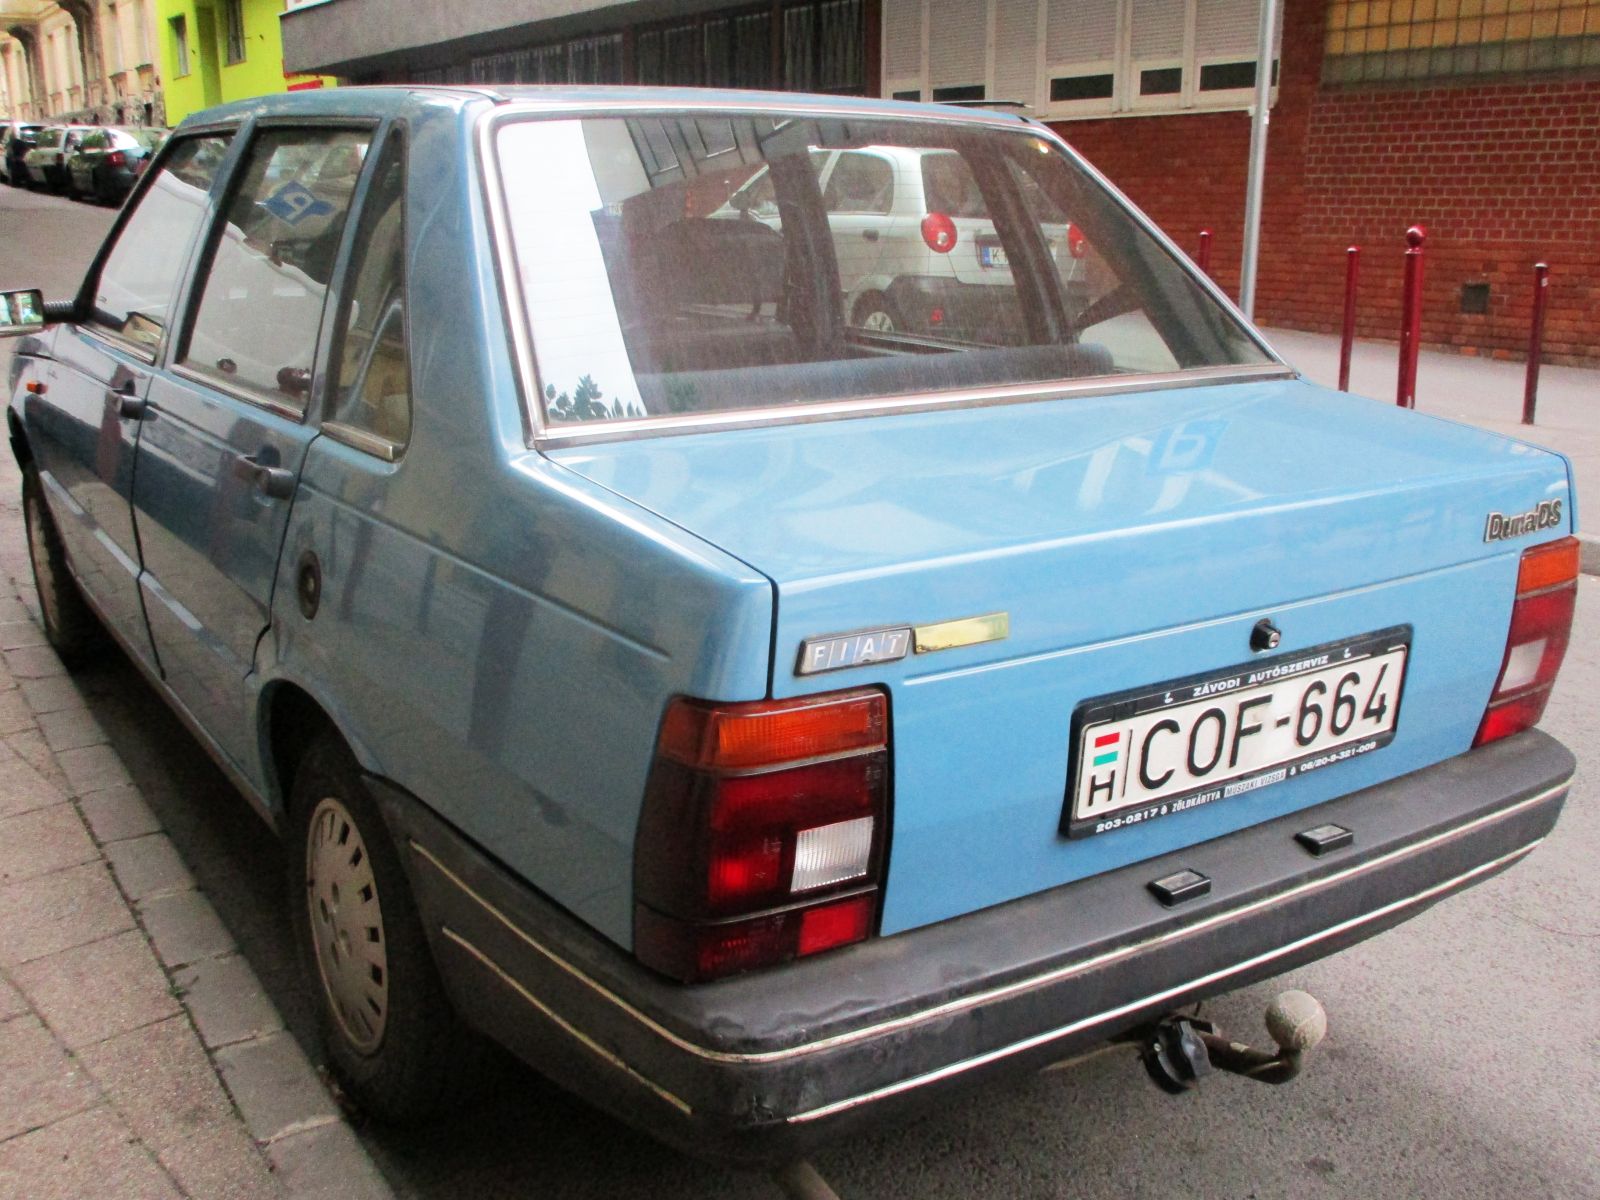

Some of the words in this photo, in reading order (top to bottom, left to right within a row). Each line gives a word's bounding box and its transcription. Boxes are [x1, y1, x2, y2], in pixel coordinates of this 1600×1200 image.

[813, 633, 903, 667] FIAT
[1193, 677, 1241, 697] ZÁVODI
[1248, 655, 1329, 684] AUTÓSZERVIZ
[1138, 662, 1389, 791] COF-664
[1088, 769, 1116, 807] H
[1095, 809, 1158, 834] 203-0217
[1171, 789, 1221, 812] ZÖLDKÁRTYA
